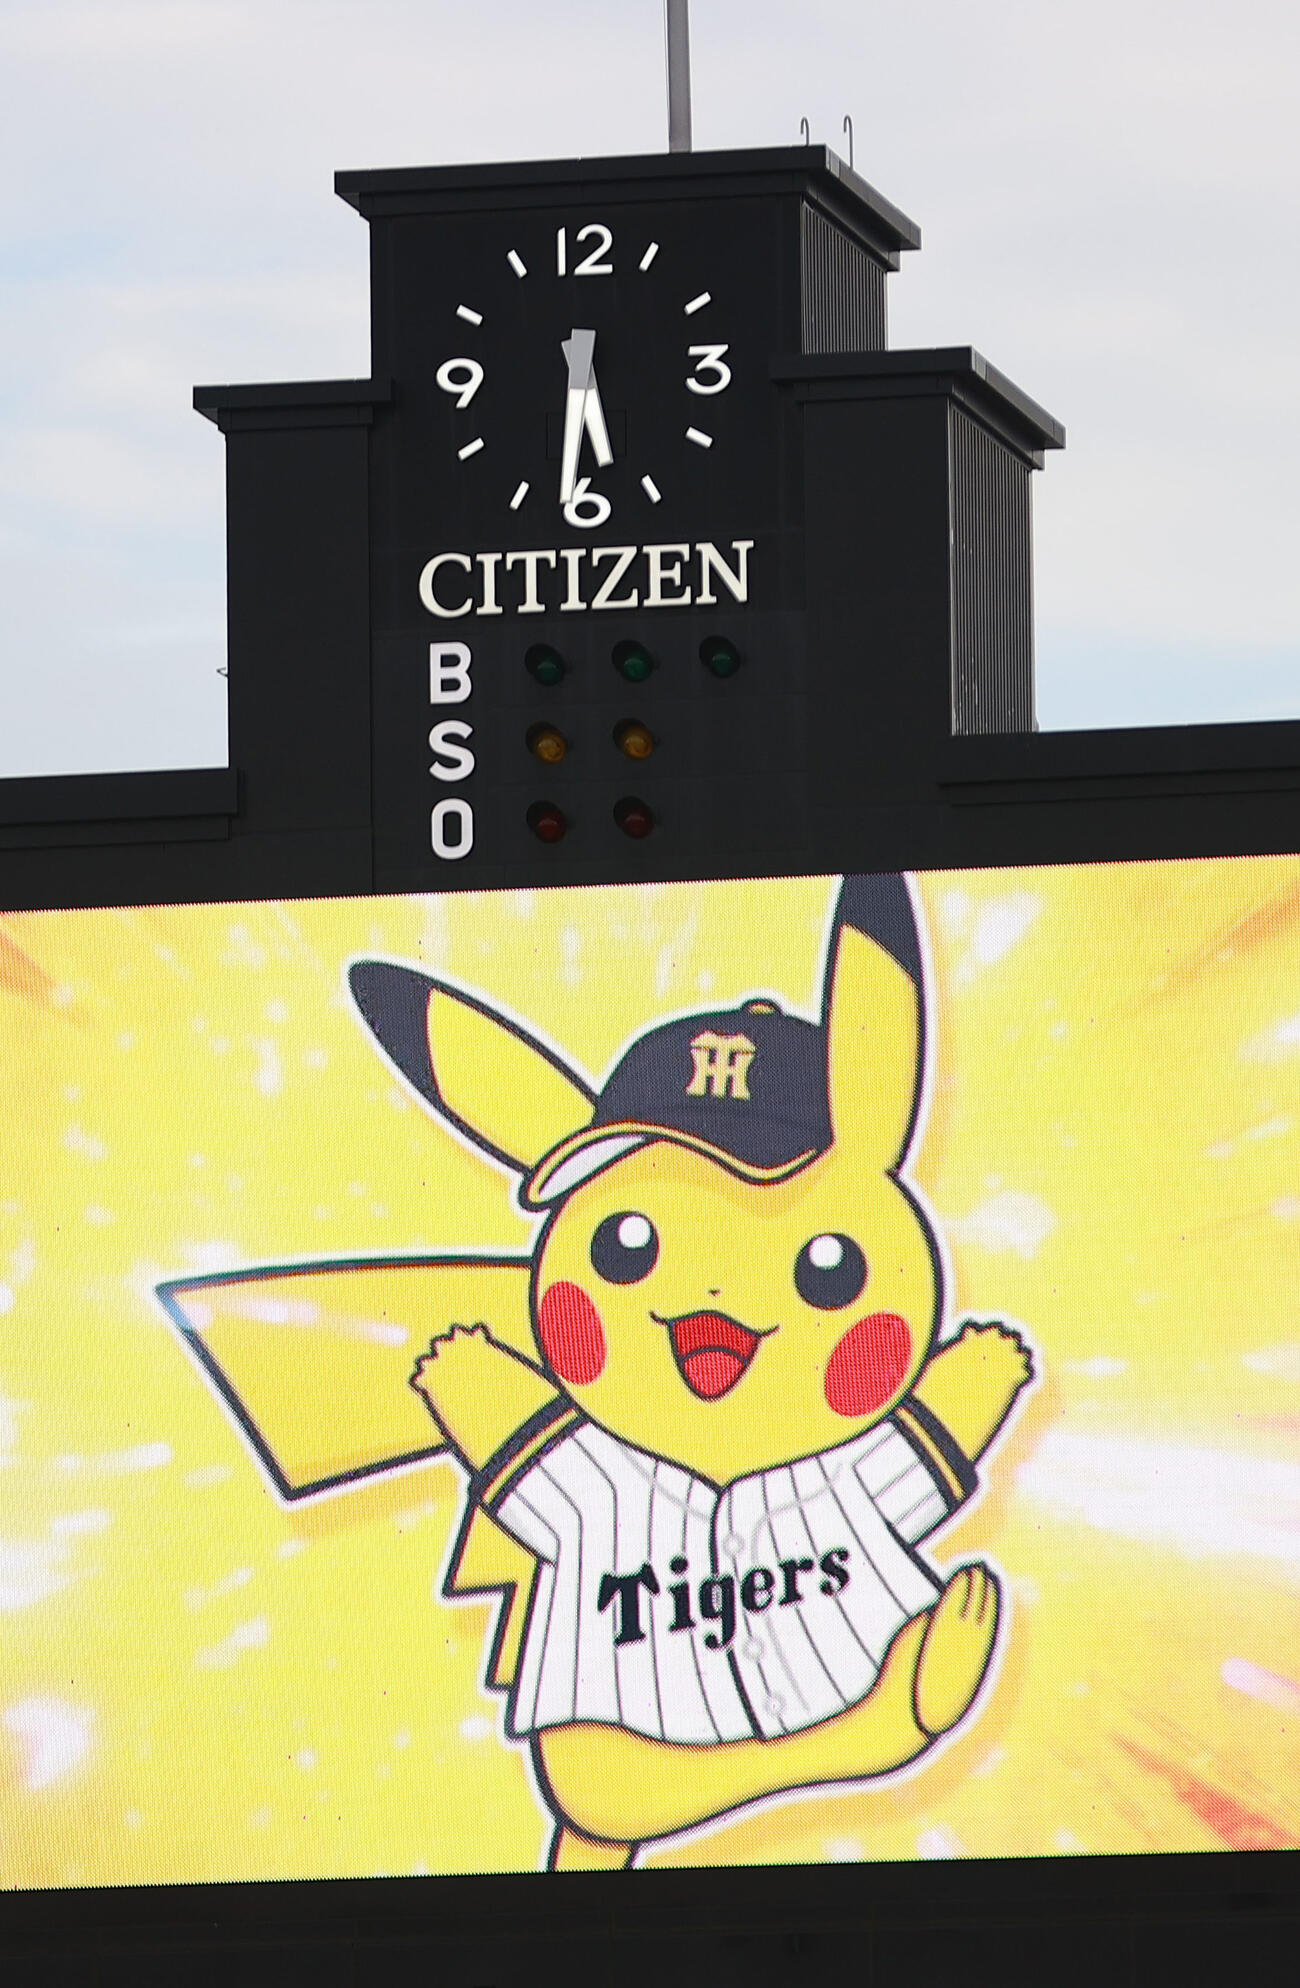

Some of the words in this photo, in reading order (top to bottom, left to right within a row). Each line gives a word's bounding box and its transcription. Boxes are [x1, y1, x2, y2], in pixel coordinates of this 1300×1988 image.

[556, 224, 613, 277] 12
[436, 358, 484, 409] 9
[686, 344, 732, 395] 3
[562, 477, 612, 529] 6
[418, 540, 755, 619] CITIZEN
[429, 641, 473, 704] B
[428, 720, 476, 782] S
[597, 1547, 850, 1650] Tigers
